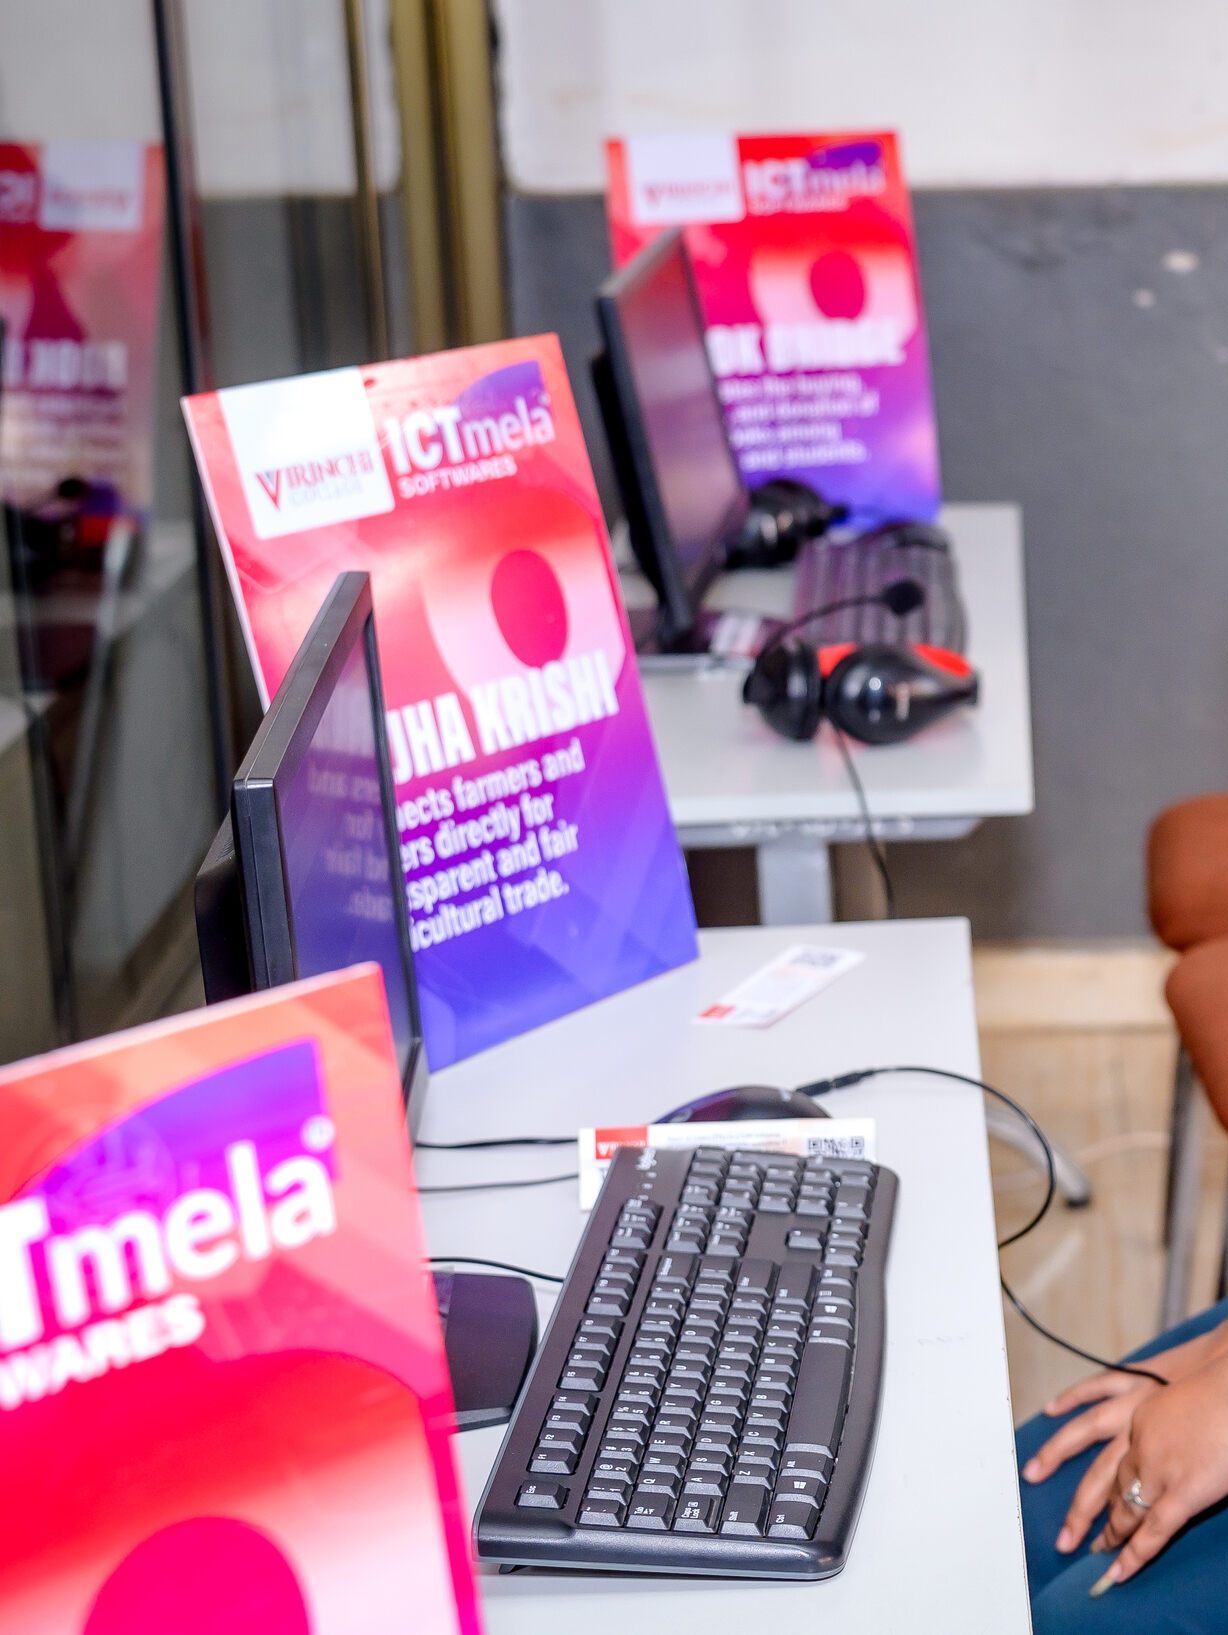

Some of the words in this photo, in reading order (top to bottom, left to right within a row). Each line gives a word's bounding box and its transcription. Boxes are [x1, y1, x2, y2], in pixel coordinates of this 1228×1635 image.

[384, 396, 555, 475] ICTmela
[398, 453, 518, 498] SOFTWARES
[385, 692, 476, 785] JHA
[471, 649, 620, 756] KRISHI
[452, 759, 542, 812] farmers
[541, 737, 586, 782] and
[401, 836, 435, 873] ers
[434, 802, 520, 859] directly
[520, 792, 554, 828] for
[406, 850, 498, 913] sparent
[496, 830, 541, 878] and
[538, 819, 579, 861] fair
[410, 885, 505, 953] icultural
[501, 866, 570, 915] trade.
[0, 1139, 337, 1346] Tmela
[0, 1293, 206, 1412] WARES
[682, 1508, 691, 1518] Caps
[690, 1508, 700, 1519] Lock
[728, 1511, 738, 1521] Shift
[776, 1514, 785, 1523] Ctrl
